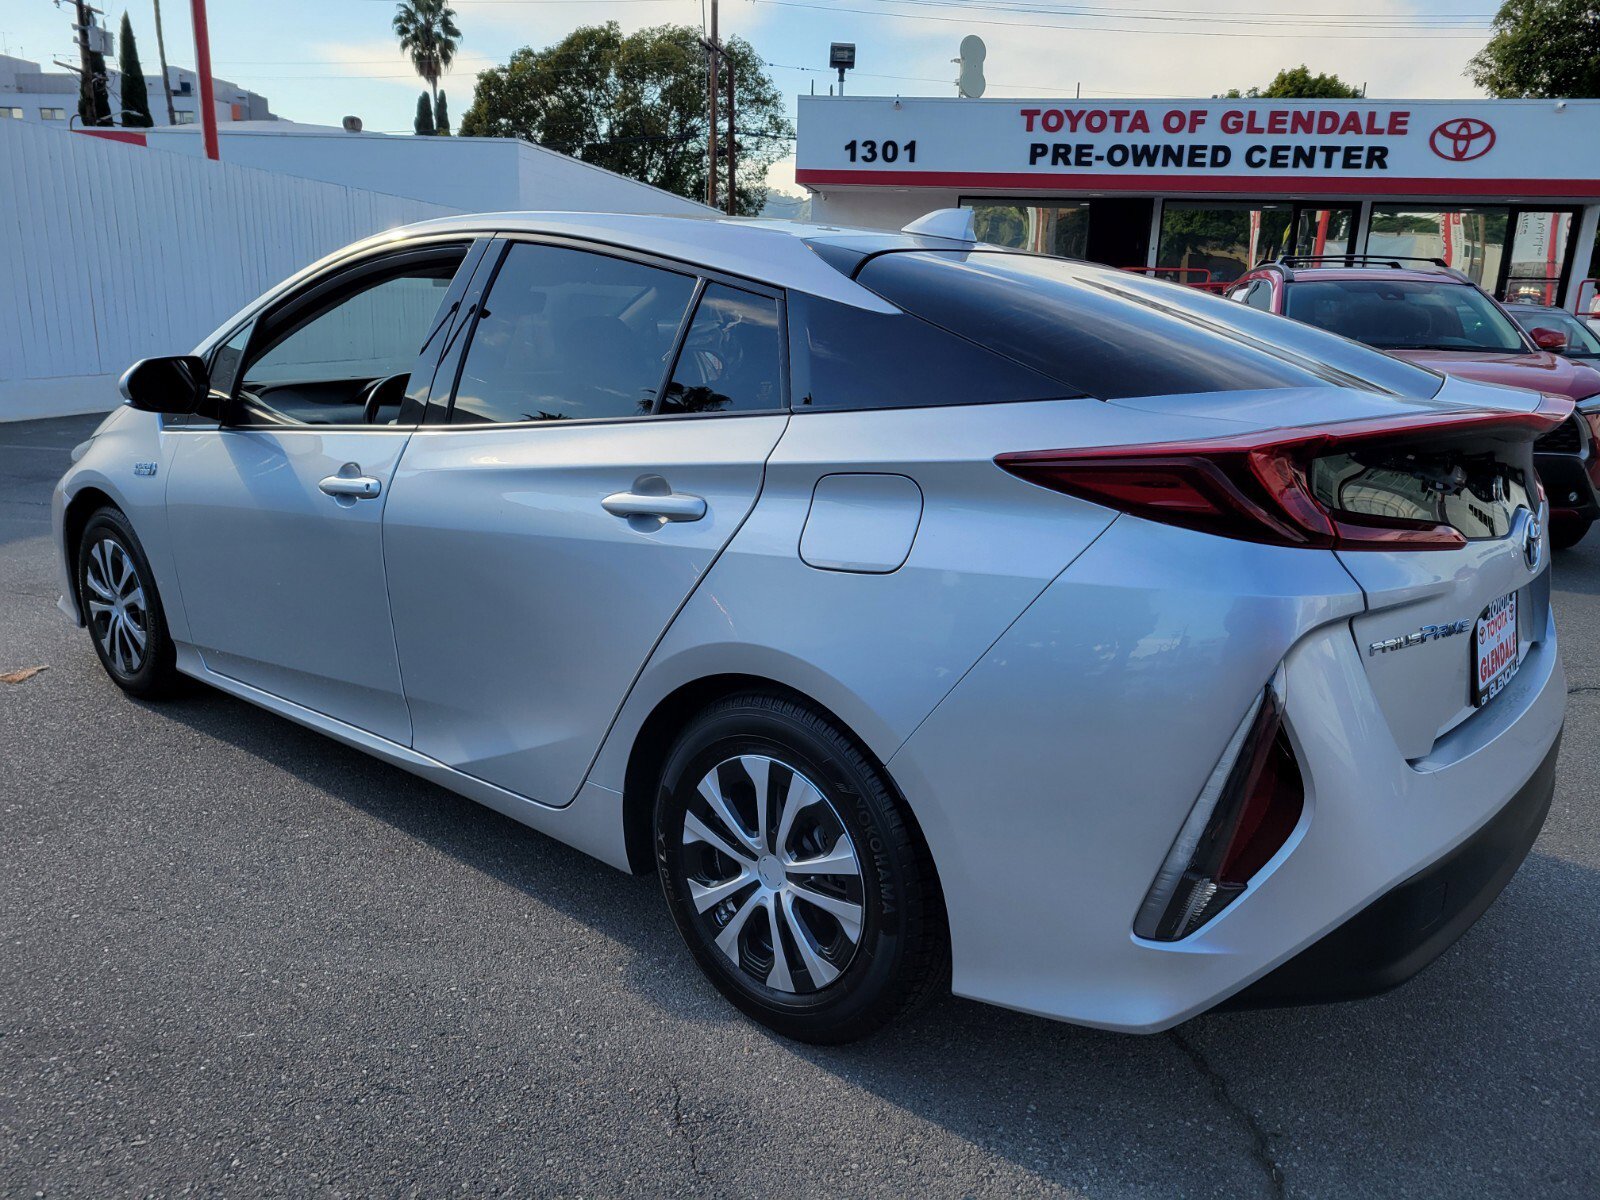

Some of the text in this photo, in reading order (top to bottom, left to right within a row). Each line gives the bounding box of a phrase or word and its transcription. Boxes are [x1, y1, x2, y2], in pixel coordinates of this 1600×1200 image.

[1020, 109, 1411, 136] TOYOTA OF GLENDALE
[844, 140, 916, 163] 1301
[1029, 143, 1389, 170] PRE-OWNED CENTER
[1486, 609, 1508, 639] TOYOTA
[1480, 631, 1517, 683] GLENDALE
[1489, 657, 1520, 702] GLENDALE
[856, 798, 896, 914] YOKOHAMA
